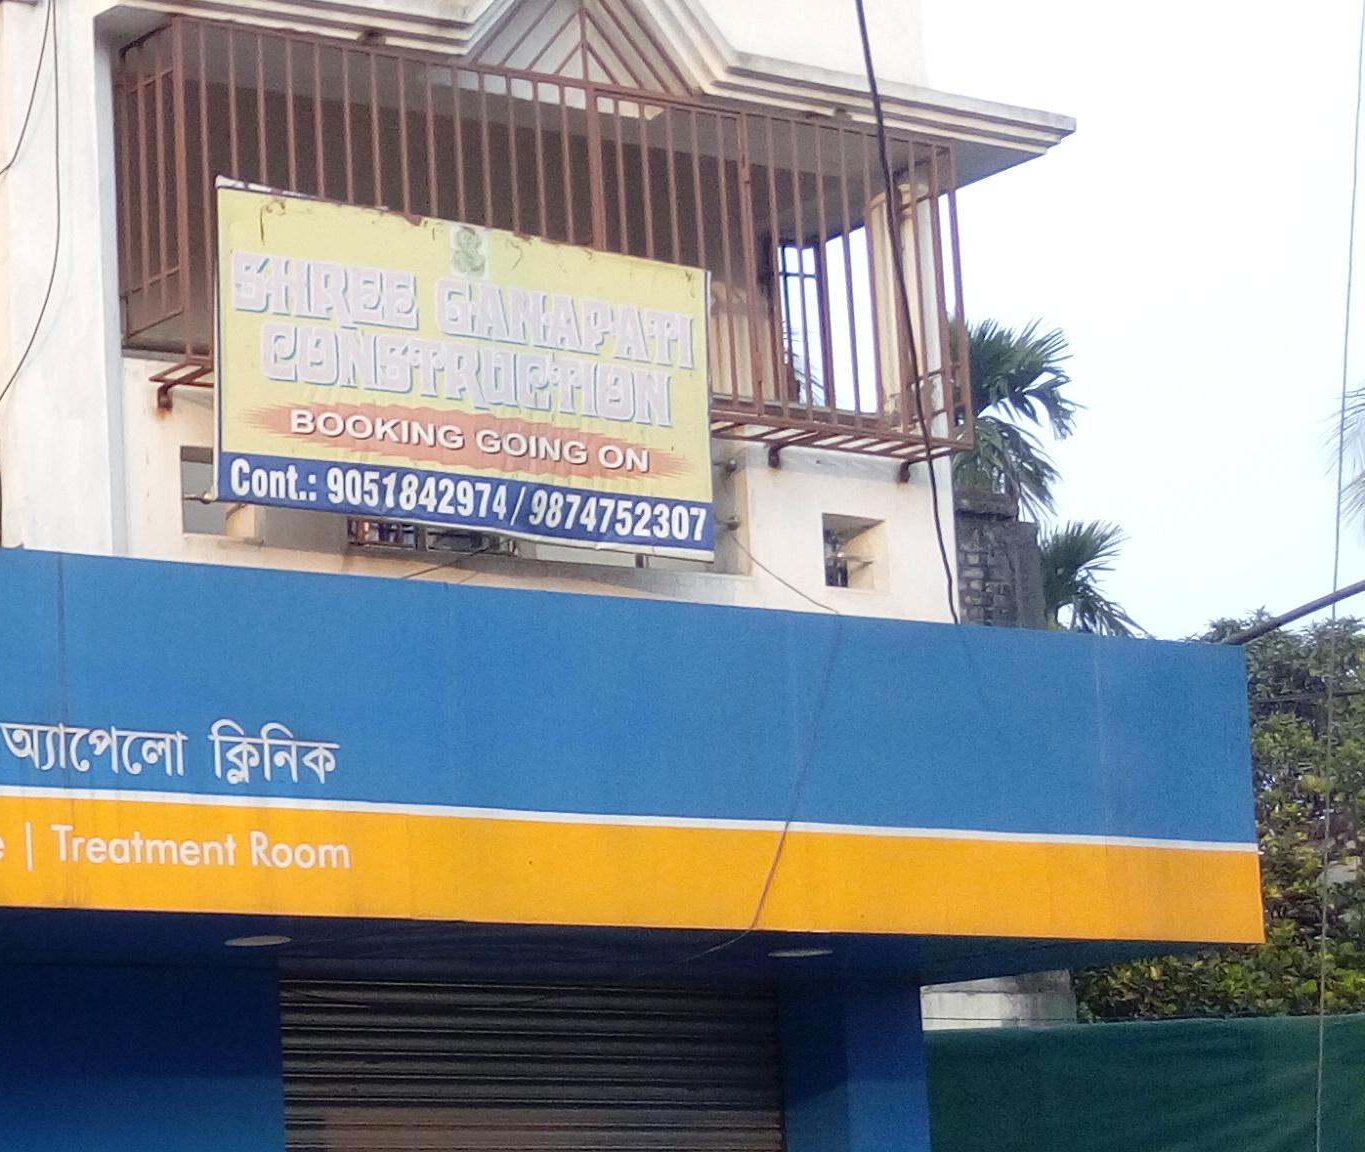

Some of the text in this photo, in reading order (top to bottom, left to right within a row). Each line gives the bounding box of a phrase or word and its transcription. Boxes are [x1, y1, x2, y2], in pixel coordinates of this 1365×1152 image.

[231, 249, 695, 369] SHREE GANAPATI
[260, 320, 673, 428] CONSTRUCTION
[289, 409, 651, 473] BOOKING GOING ON
[230, 457, 317, 501] Cont.:
[327, 466, 508, 521] 9051842974
[531, 488, 707, 541] 9874752307
[208, 714, 340, 785] ক্লিনিক
[50, 824, 235, 866] Treatment
[250, 831, 351, 869] Room
